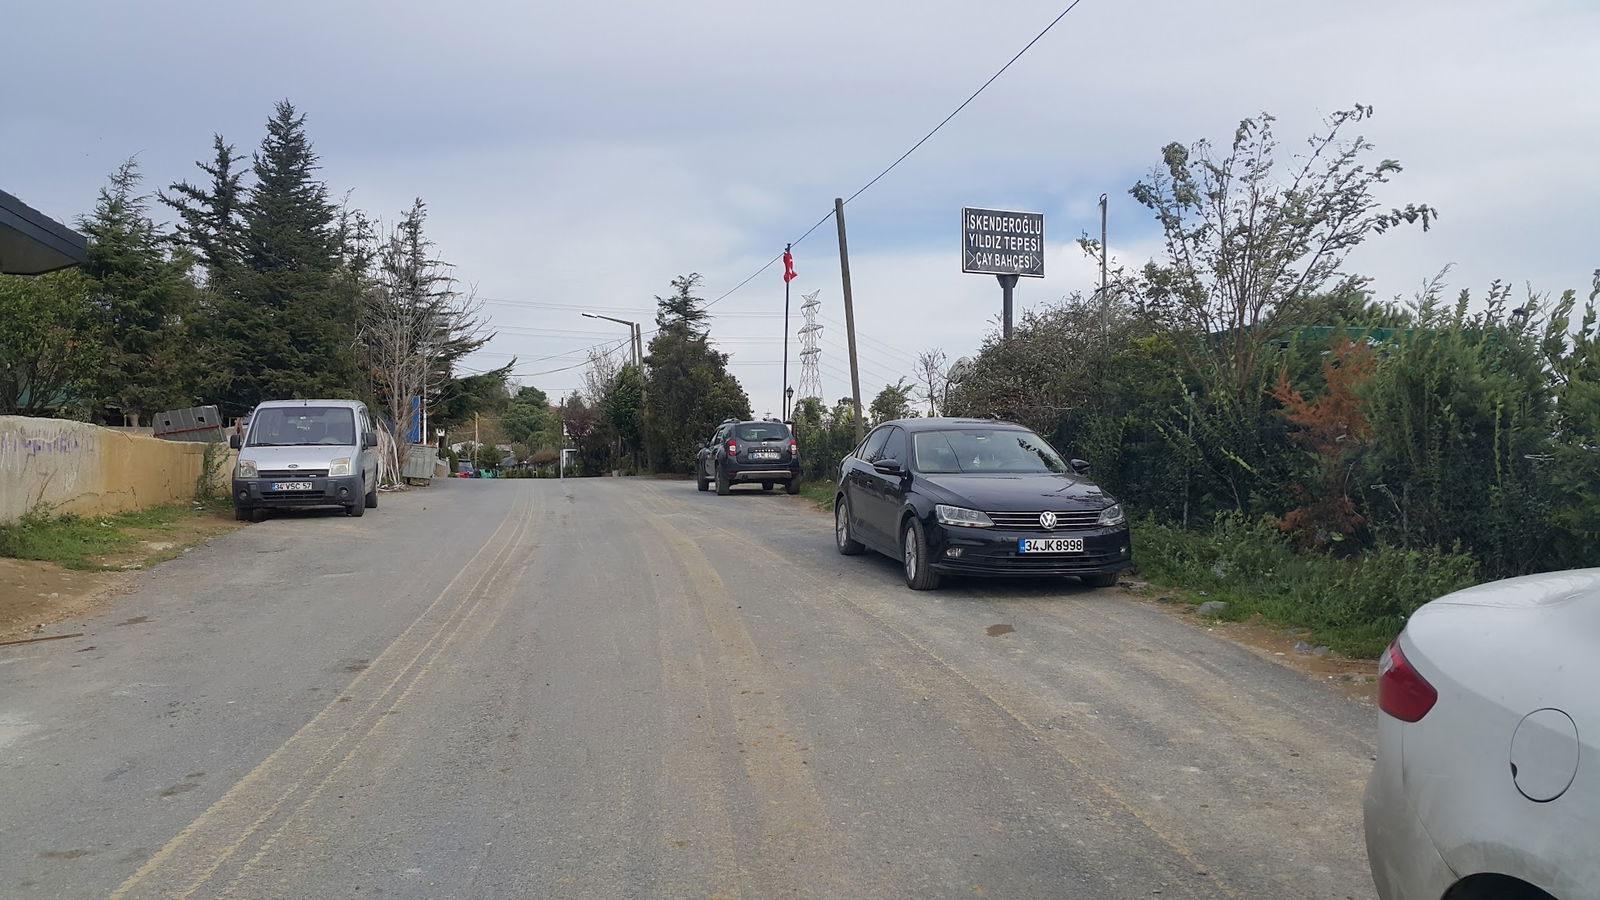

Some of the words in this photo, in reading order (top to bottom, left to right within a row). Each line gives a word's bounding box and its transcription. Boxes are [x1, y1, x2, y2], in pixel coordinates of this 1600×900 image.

[966, 211, 1041, 234] İSKENDEROĞLU
[969, 233, 1002, 249] YILDIZ
[1004, 236, 1040, 252] TEPESİ
[976, 252, 993, 268] ÇAY
[995, 253, 1033, 271] BAHÇESİ
